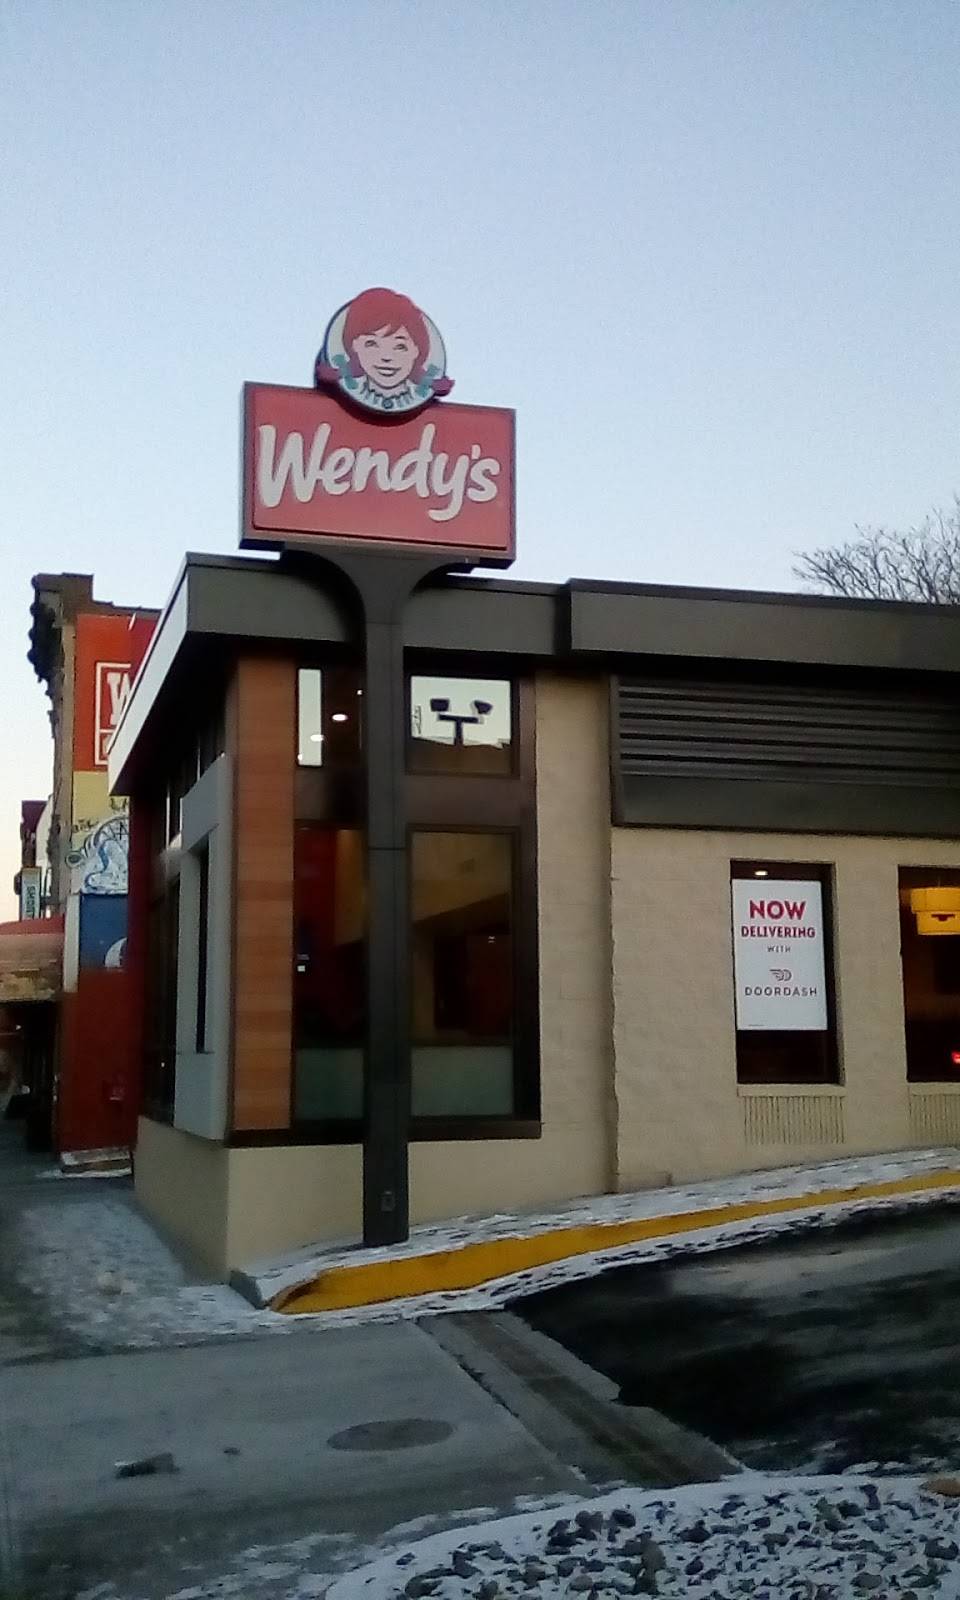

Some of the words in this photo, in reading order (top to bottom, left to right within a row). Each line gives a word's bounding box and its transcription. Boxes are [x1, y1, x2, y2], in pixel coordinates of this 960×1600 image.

[258, 423, 501, 522] Wendy's
[750, 900, 806, 921] NOW
[741, 925, 816, 938] DELIVERING
[767, 945, 791, 953] WITH
[744, 986, 817, 997] DOORDASH
